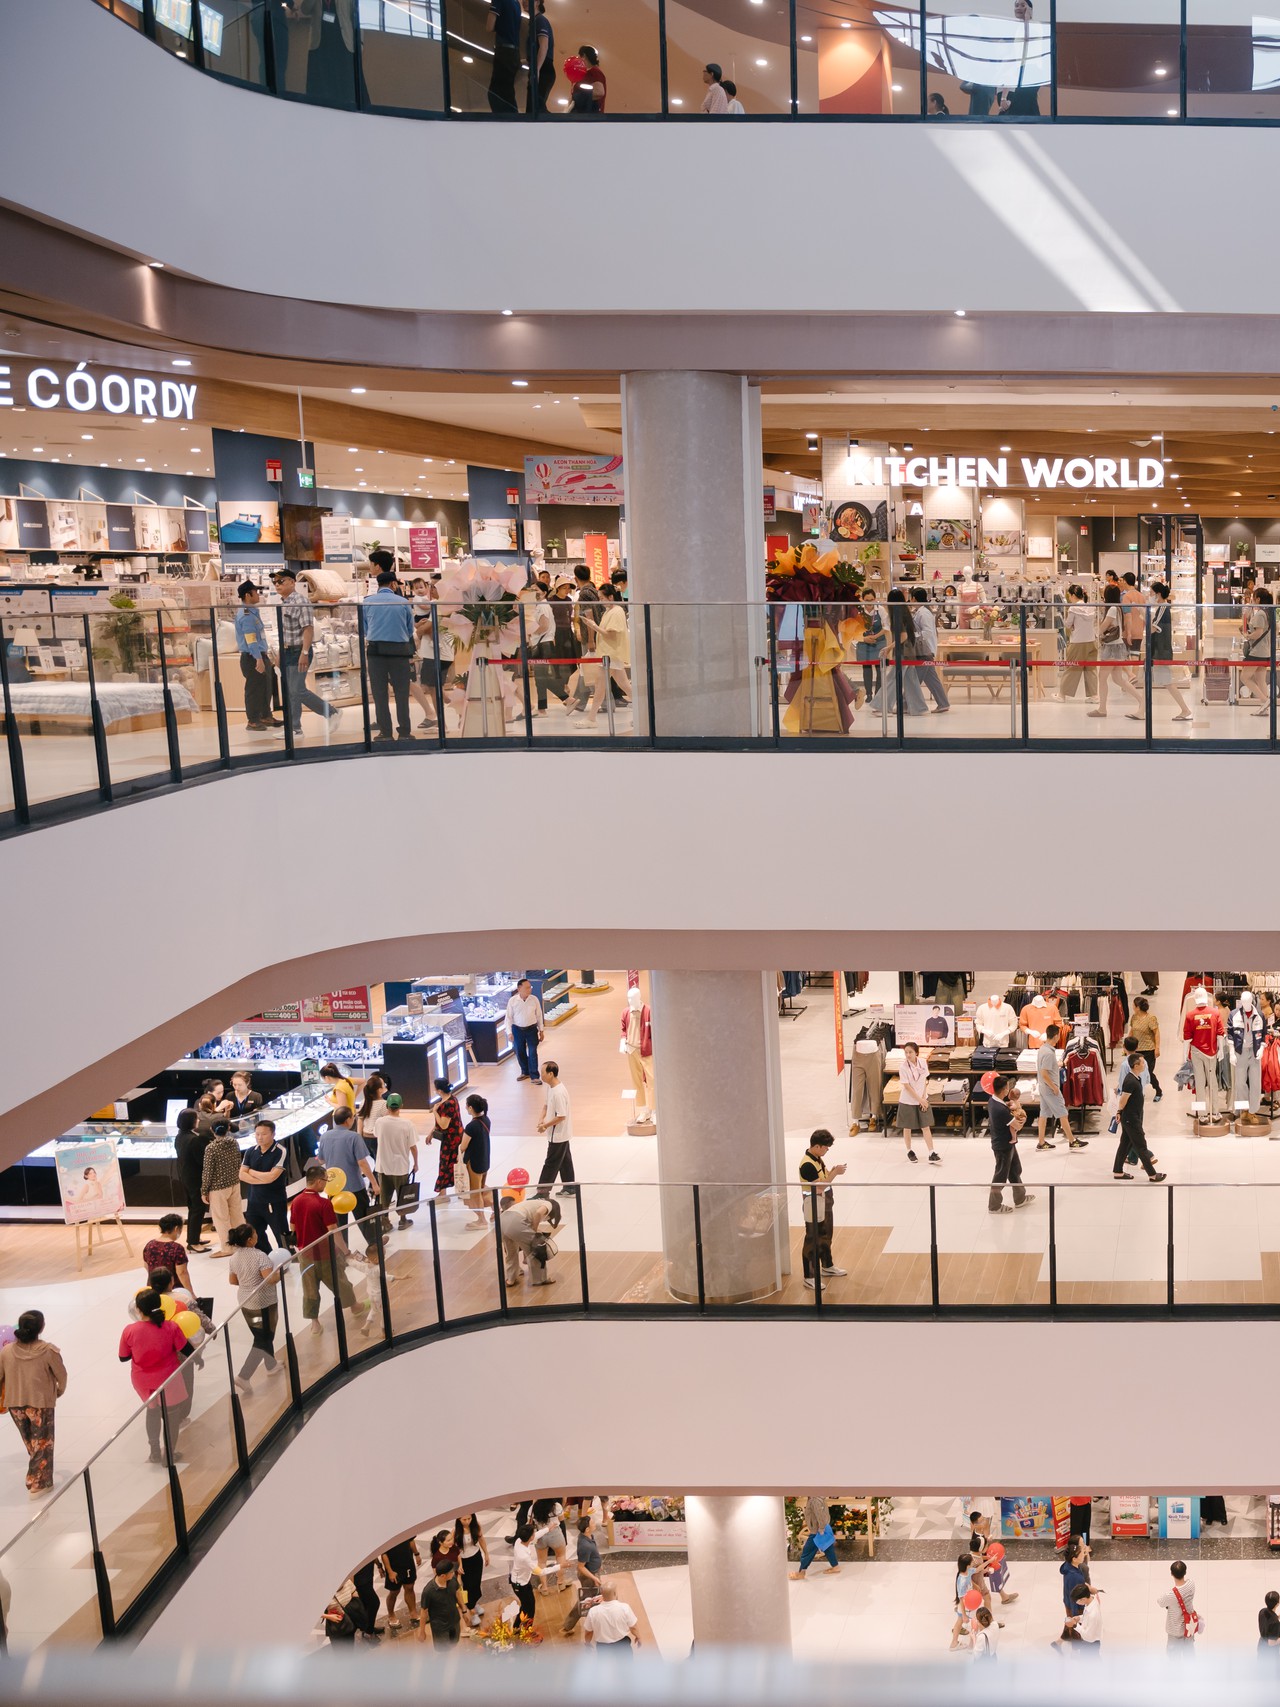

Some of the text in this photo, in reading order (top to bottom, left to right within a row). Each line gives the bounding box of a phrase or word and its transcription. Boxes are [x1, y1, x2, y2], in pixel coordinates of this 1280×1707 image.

[28, 362, 197, 419] CÓORDY
[846, 456, 1165, 488] KITCHEN WORLD
[332, 1000, 343, 1009] 01
